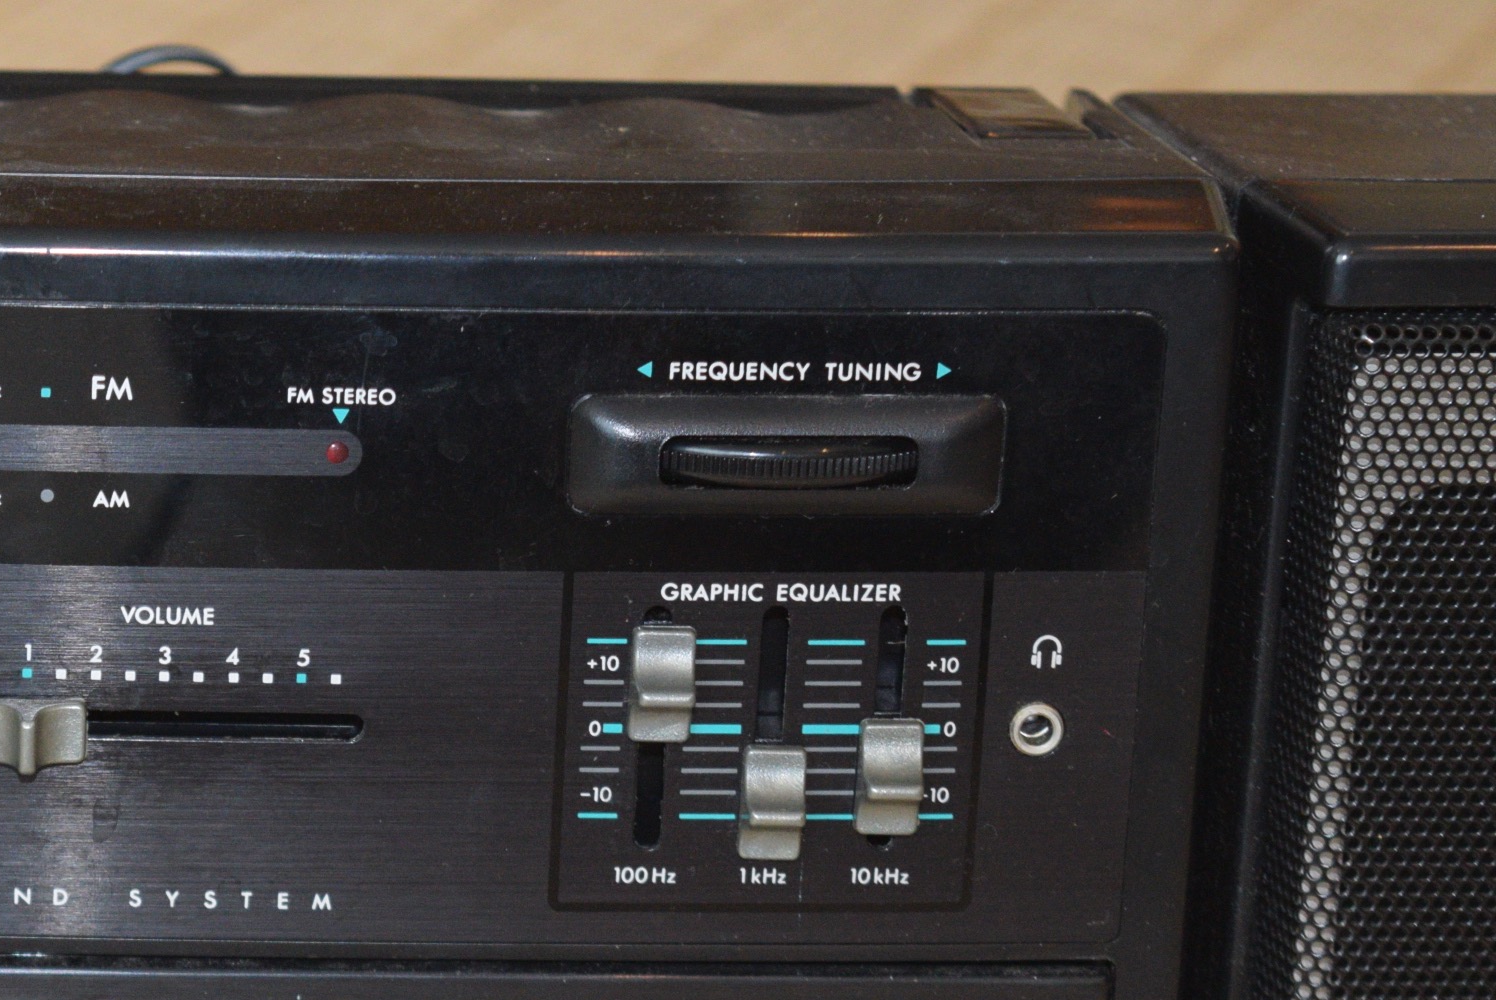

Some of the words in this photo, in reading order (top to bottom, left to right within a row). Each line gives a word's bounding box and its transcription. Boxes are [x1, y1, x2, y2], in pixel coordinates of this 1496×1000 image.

[668, 361, 811, 382] FREQUENCY
[825, 362, 922, 382] TUNING
[91, 374, 133, 401] FM
[287, 386, 315, 404] FM
[321, 386, 397, 406] STEREO
[92, 490, 130, 508] AM
[660, 582, 764, 602] GRAPHIC
[776, 582, 901, 603] EQUALIZER
[120, 605, 215, 626] VOLUME
[24, 642, 33, 662] 1
[89, 643, 103, 663] 2
[158, 645, 172, 665] 3
[225, 647, 240, 666] 4
[296, 648, 311, 668] 5
[587, 654, 620, 672] +10
[927, 656, 960, 674] +10
[580, 786, 613, 803] -10
[128, 888, 332, 911] SYSTEM
